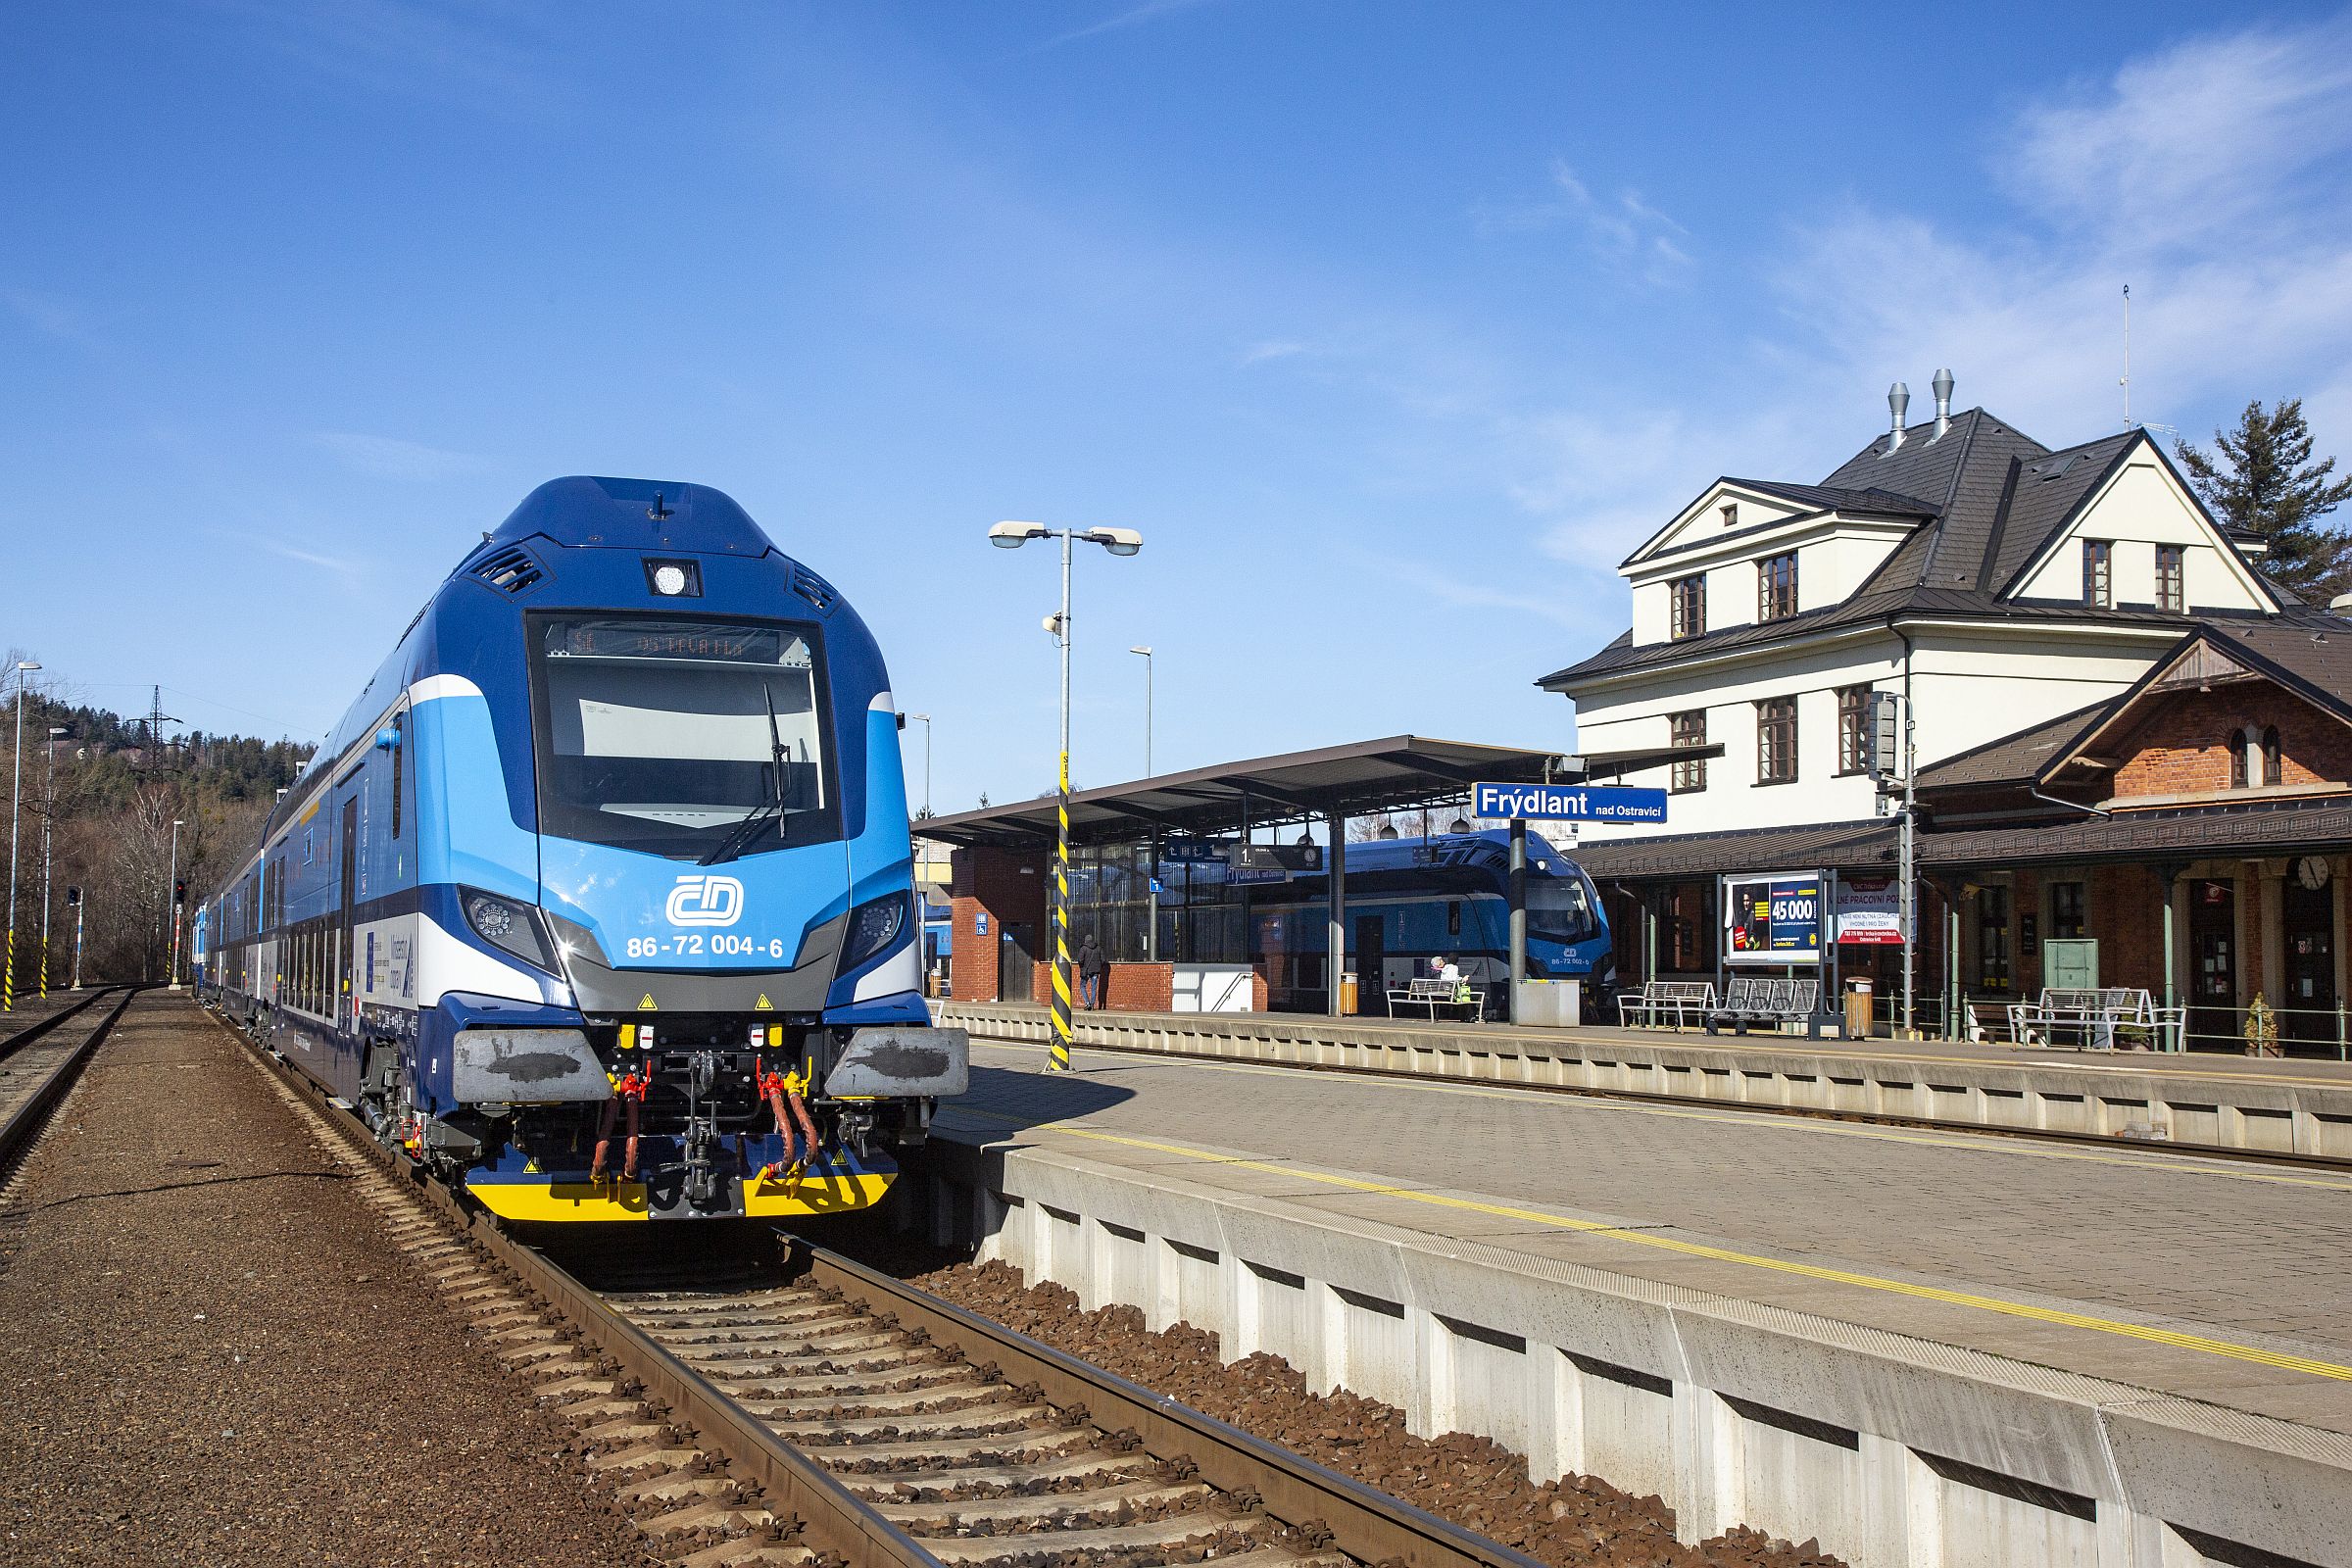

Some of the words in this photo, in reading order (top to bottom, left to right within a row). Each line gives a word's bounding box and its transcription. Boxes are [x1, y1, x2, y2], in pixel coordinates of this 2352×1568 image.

[1482, 788, 1588, 817] Frýdlant
[1595, 806, 1615, 815] nad
[1617, 806, 1662, 817] Ostravicí
[627, 934, 704, 958] 86-72
[710, 934, 783, 958] 004-6
